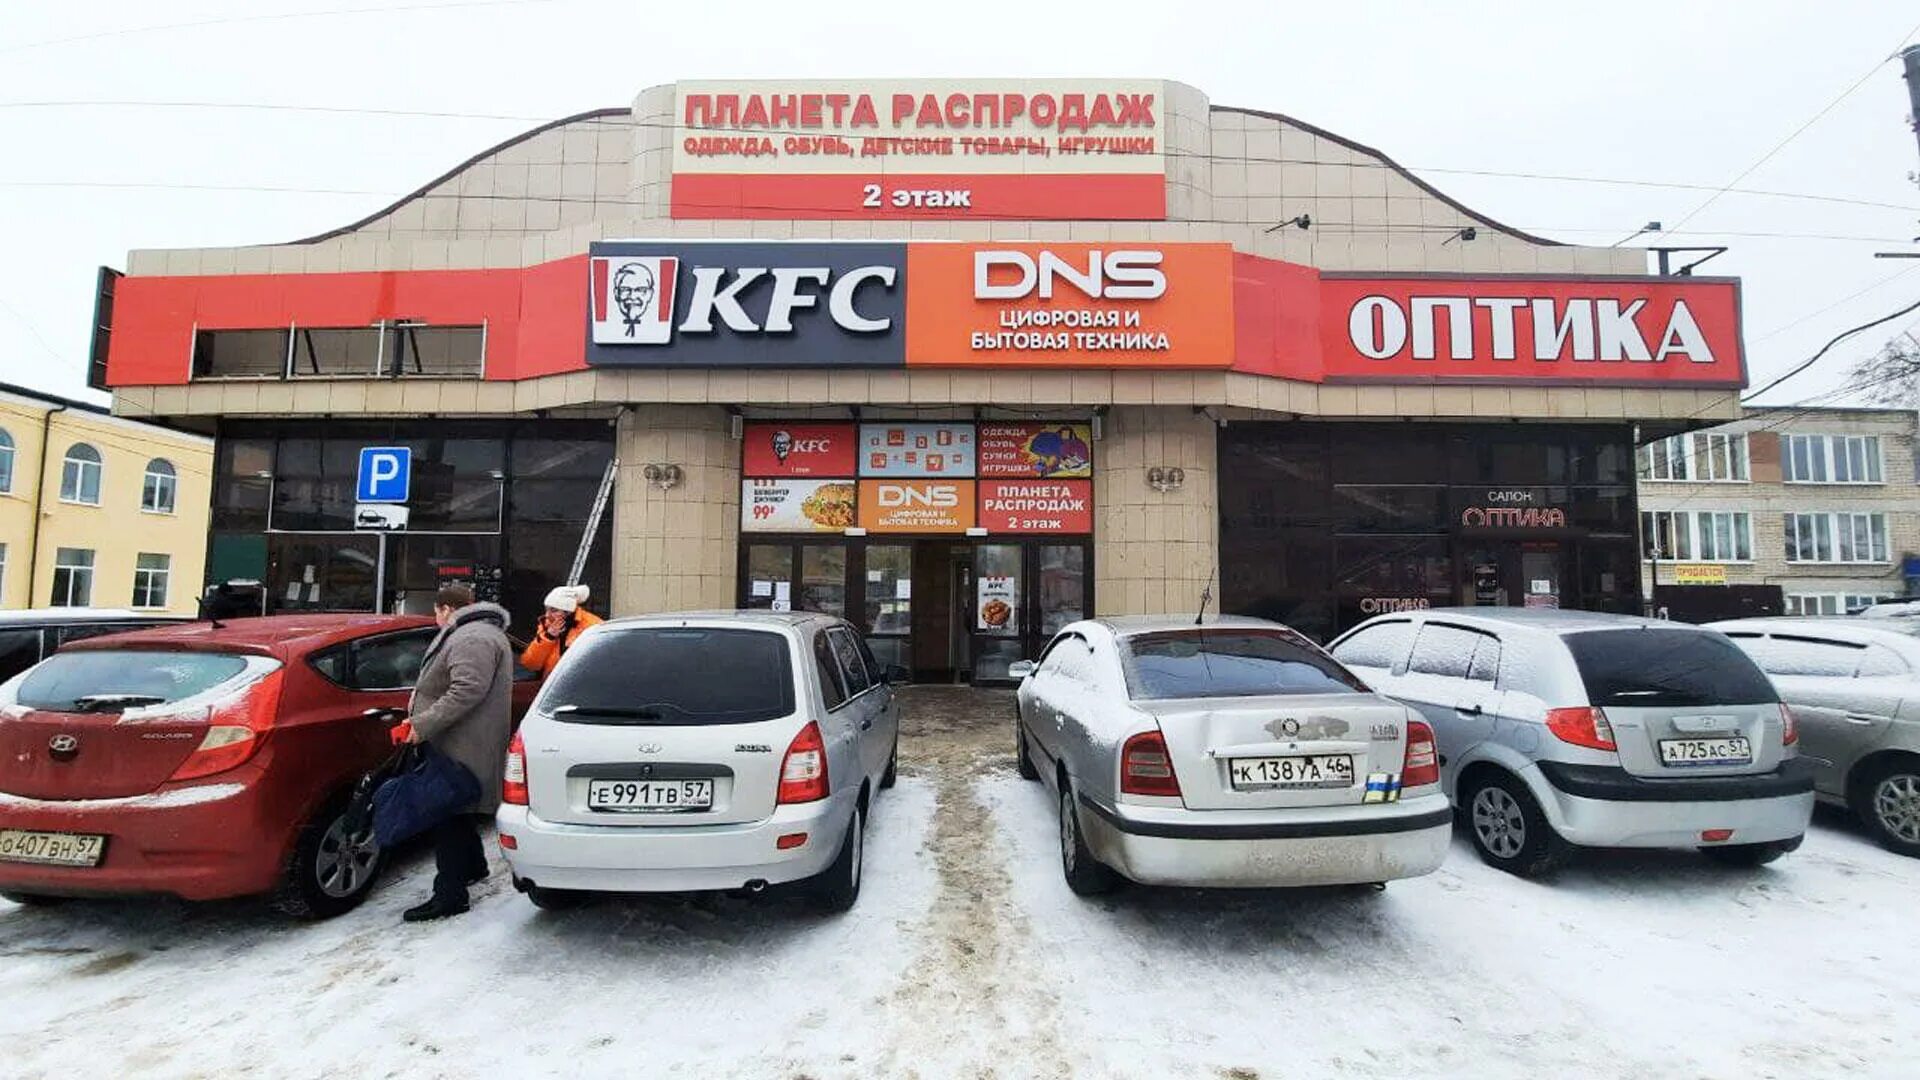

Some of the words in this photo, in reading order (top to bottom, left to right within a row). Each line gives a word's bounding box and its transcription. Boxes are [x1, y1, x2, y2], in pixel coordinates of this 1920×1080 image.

[685, 94, 879, 128] ПЛАНЕТА
[891, 93, 1156, 133] РАСПРОДАЖ
[683, 137, 778, 158] ОДЕЖДА,
[784, 137, 854, 158] ОБУВЬ,
[861, 136, 953, 157] ДЕТСКИЕ
[960, 137, 1050, 158] ТОВАРЫ,
[1058, 137, 1154, 156] ИГРУШКИ
[863, 184, 882, 208] 2
[892, 190, 971, 208] этаж
[974, 250, 1166, 299] DNS
[678, 266, 897, 332] KFC
[1000, 310, 1118, 328] ЦИФРОВАЯ
[1124, 311, 1140, 327] И
[1348, 294, 1716, 363] ОПТИКА
[971, 332, 1069, 350] БЫТОВАЯ
[1075, 332, 1169, 350] ТЕХНИКА
[982, 428, 1027, 437] ОДЕЖДА
[792, 440, 830, 453] KFC
[982, 452, 1017, 460] СУМКИ
[370, 454, 399, 496] P
[982, 464, 1032, 472] ИГРУШКИ
[878, 485, 959, 507] DNS
[997, 486, 1072, 498] ПЛАНЕТА
[1488, 491, 1532, 502] САЛОН
[985, 500, 1085, 513] РАСПРОДАЖ
[1008, 517, 1018, 529] 2
[1023, 519, 1062, 529] этаж
[1462, 505, 1566, 528] ОПТИКА
